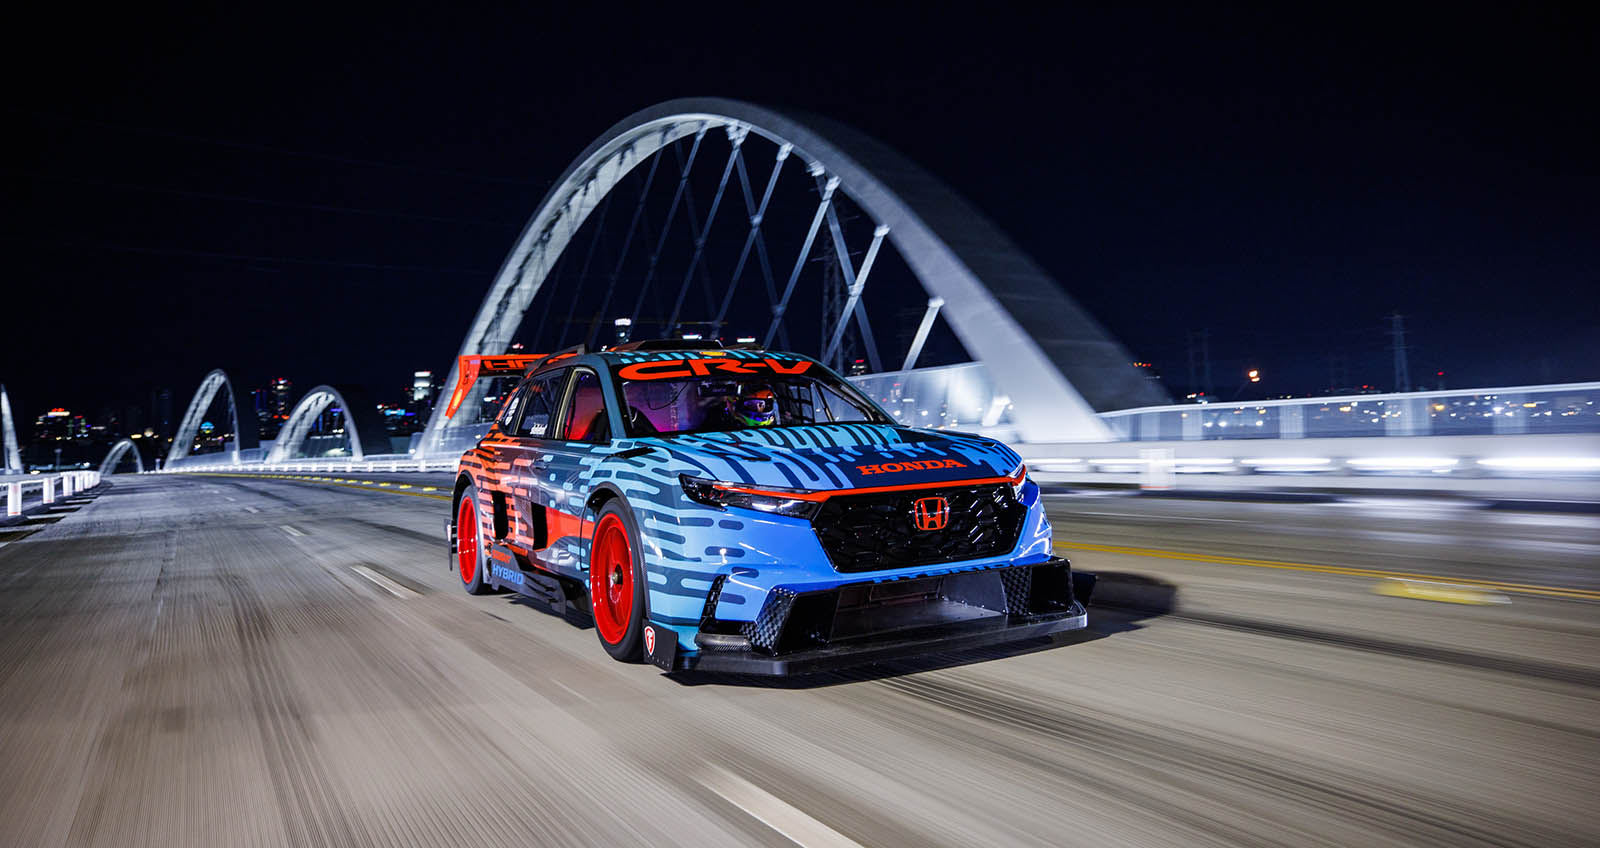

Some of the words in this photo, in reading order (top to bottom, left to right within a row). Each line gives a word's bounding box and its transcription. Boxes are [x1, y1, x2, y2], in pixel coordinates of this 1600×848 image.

[618, 359, 813, 380] CR-V
[855, 459, 968, 475] HONDA
[492, 564, 524, 585] HYBRID
